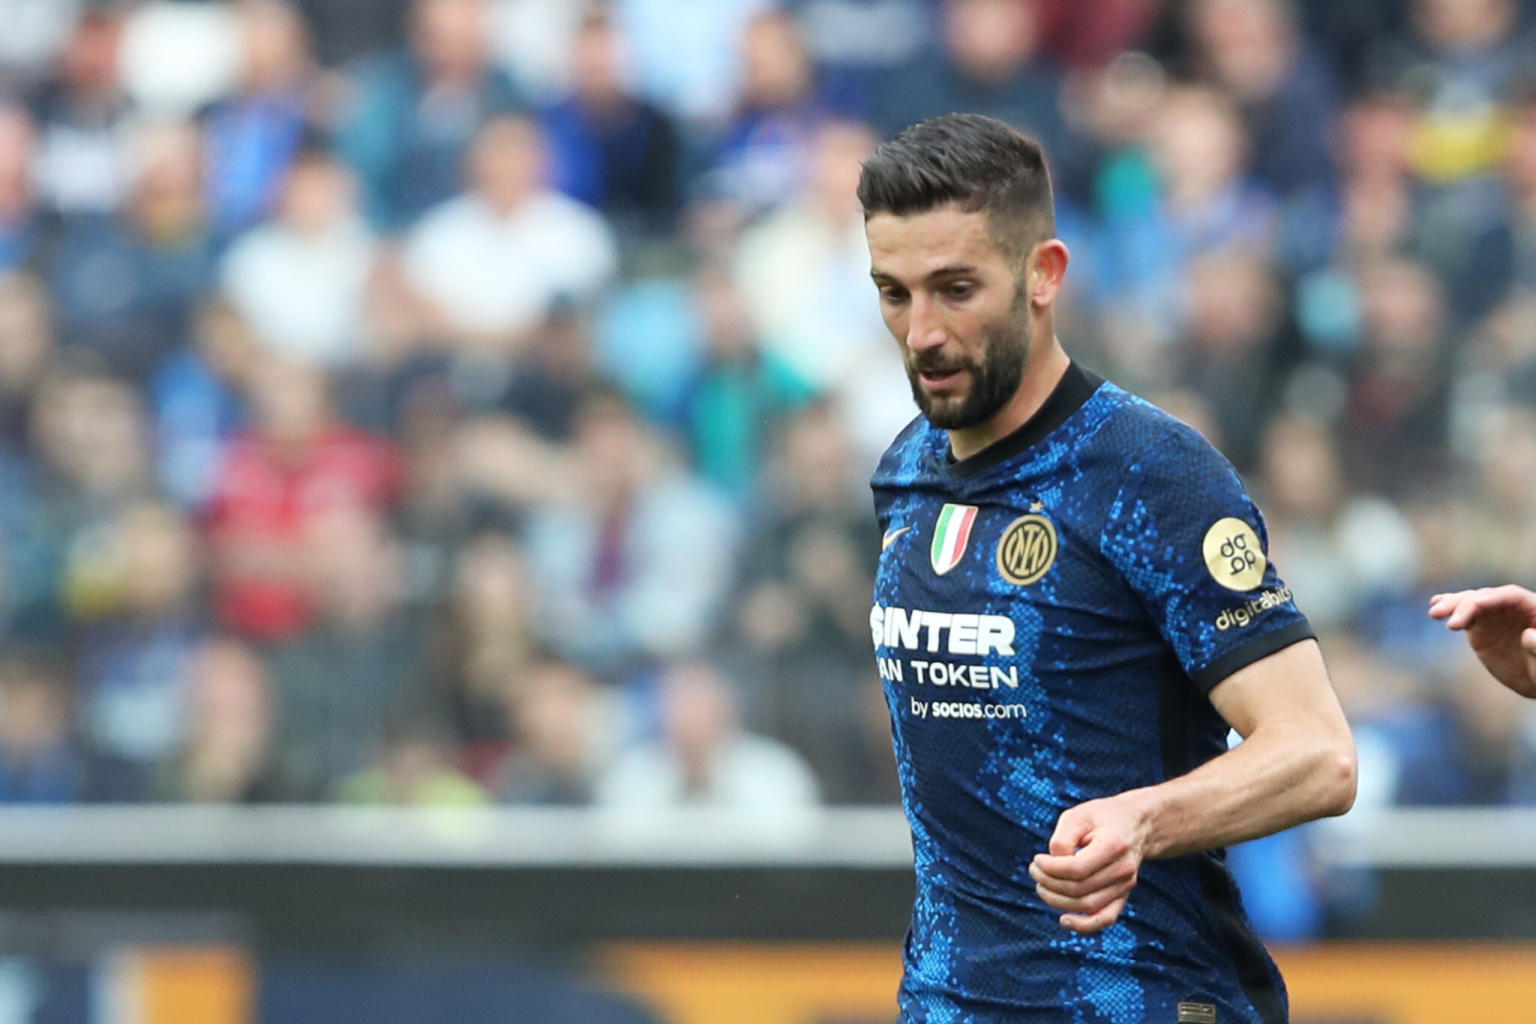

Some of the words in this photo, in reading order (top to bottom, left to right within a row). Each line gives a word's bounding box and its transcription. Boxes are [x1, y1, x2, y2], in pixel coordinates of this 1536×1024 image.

[877, 657, 903, 682] AN
[910, 660, 1019, 689] TOKEN
[910, 696, 929, 719] by
[931, 701, 1028, 719] socios.com
